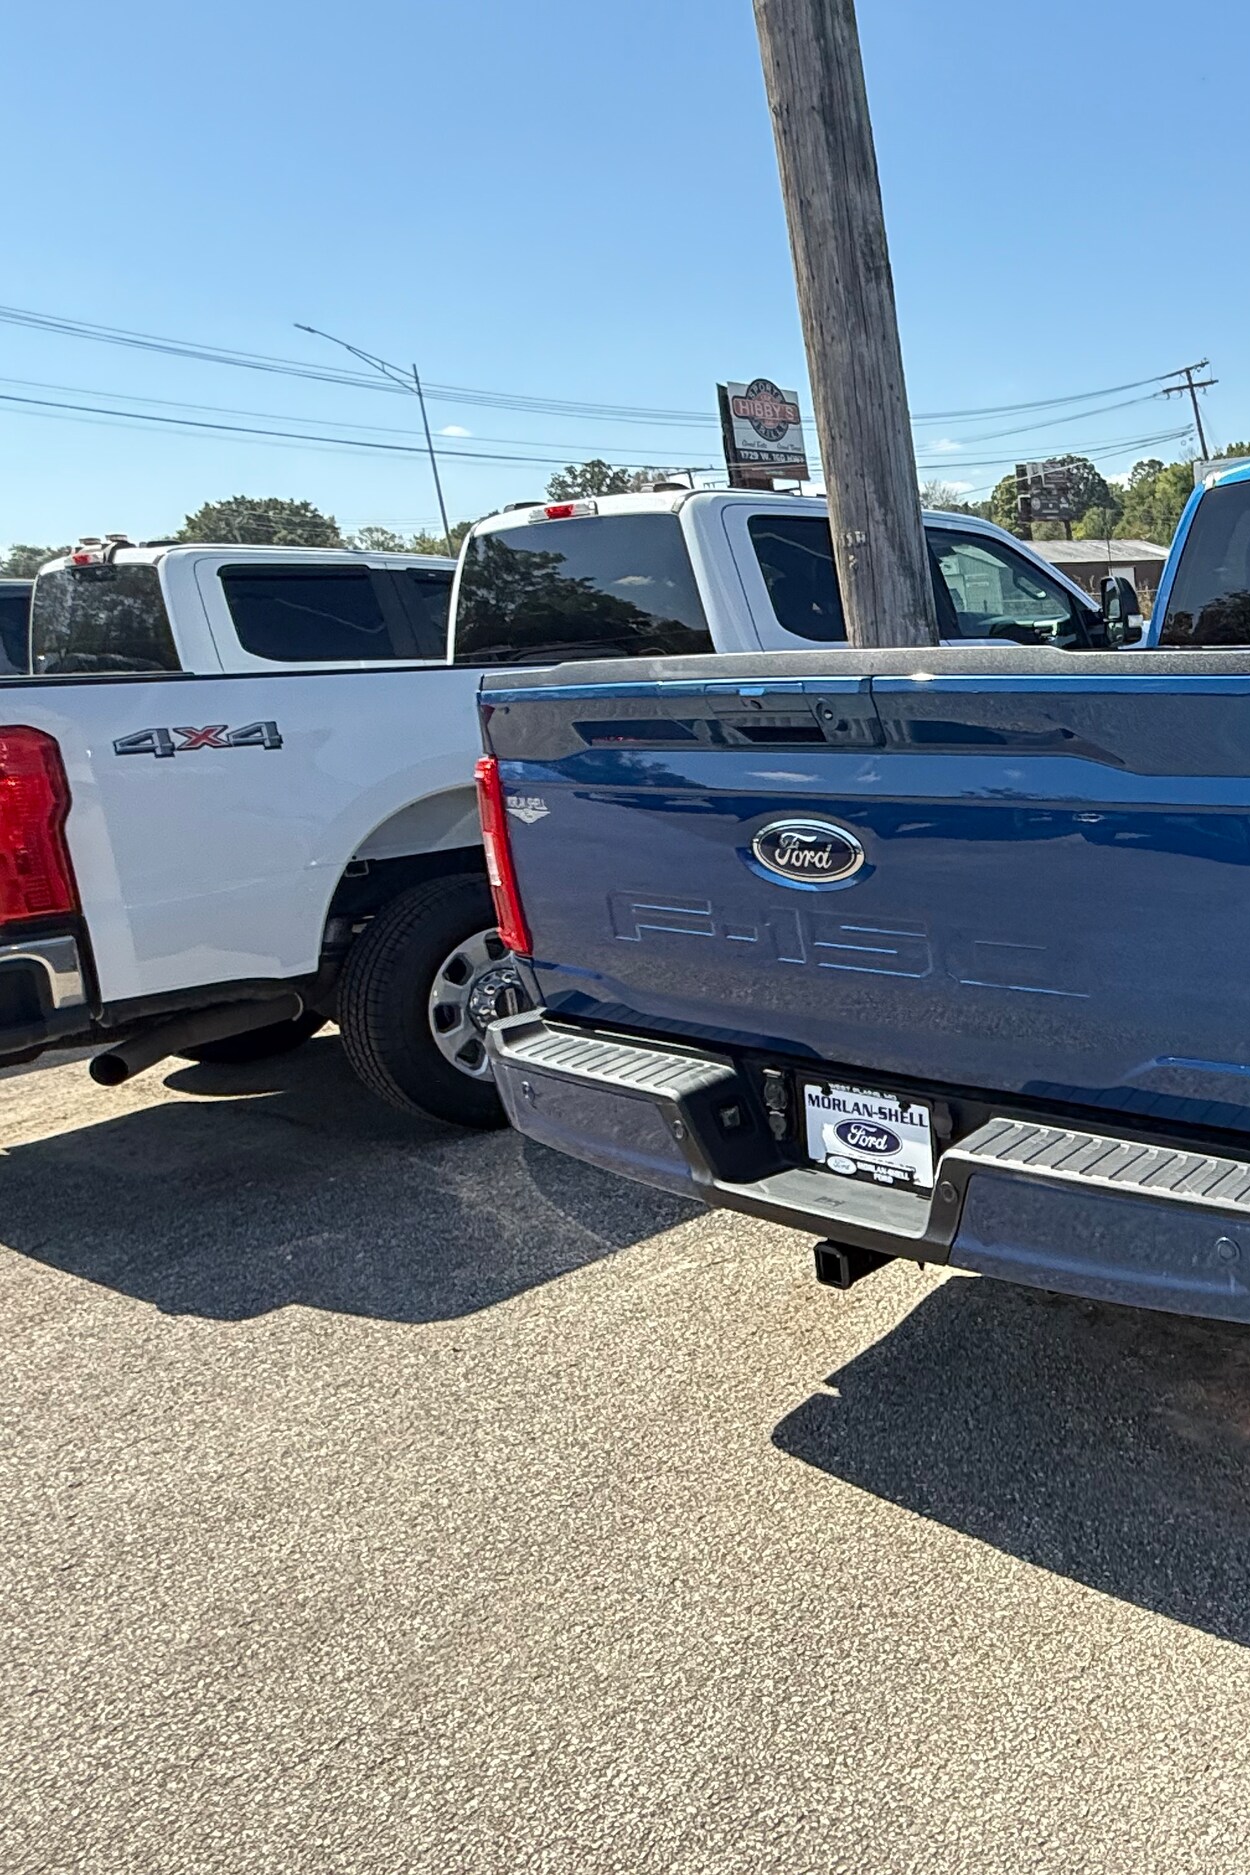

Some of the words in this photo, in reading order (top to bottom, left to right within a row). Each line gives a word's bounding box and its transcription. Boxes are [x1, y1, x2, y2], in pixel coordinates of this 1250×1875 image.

[738, 399, 794, 420] HIBBY'S
[774, 831, 833, 870] Ford
[808, 1093, 929, 1128] MORLAN-SHELL
[847, 1123, 888, 1151] Ford
